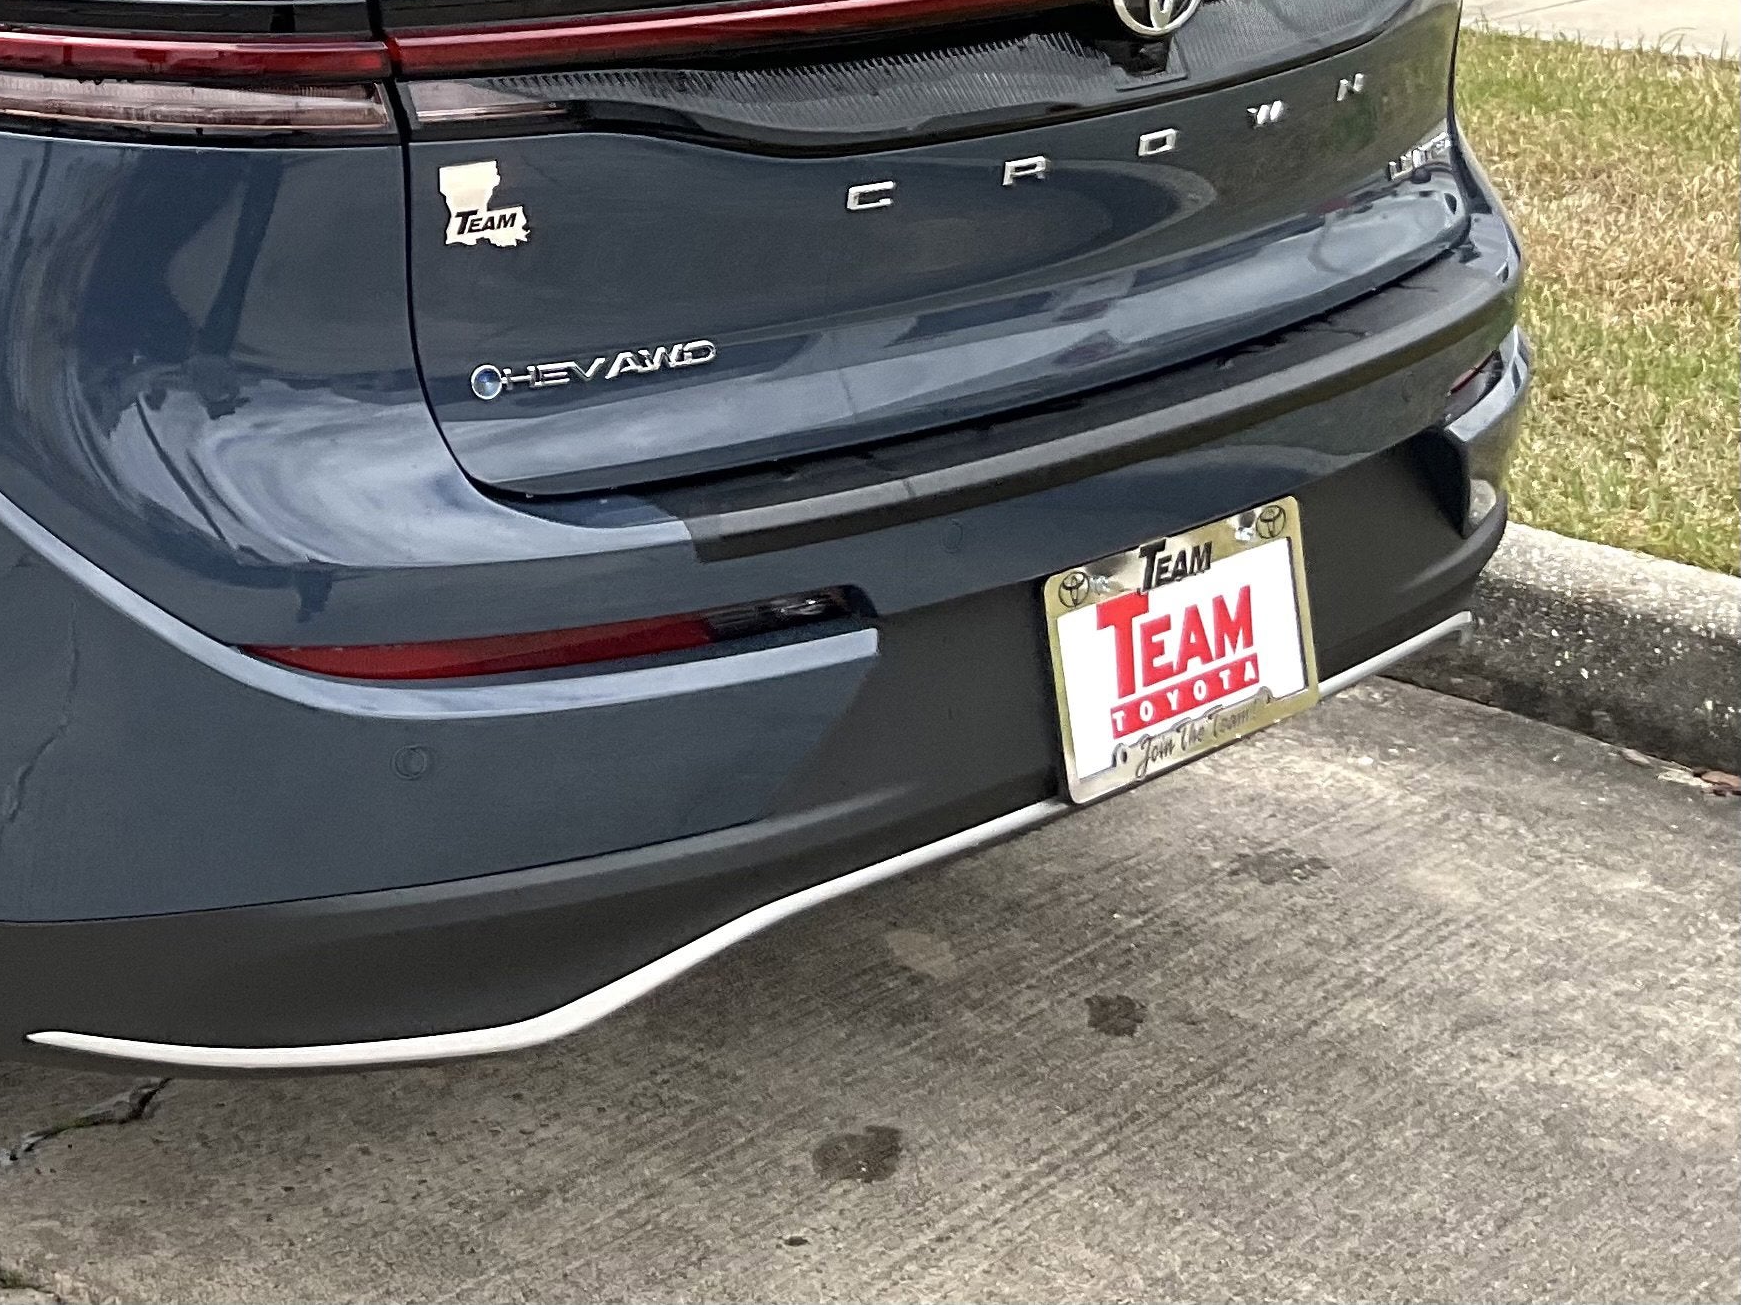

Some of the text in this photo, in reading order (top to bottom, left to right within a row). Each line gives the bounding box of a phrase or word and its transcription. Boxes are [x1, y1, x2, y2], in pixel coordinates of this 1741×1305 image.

[846, 73, 1364, 211] CROWN
[455, 208, 518, 236] TEAM
[1138, 539, 1213, 593] TEAM
[1096, 584, 1254, 700] TEAM
[1112, 660, 1257, 732] TOYOTA
